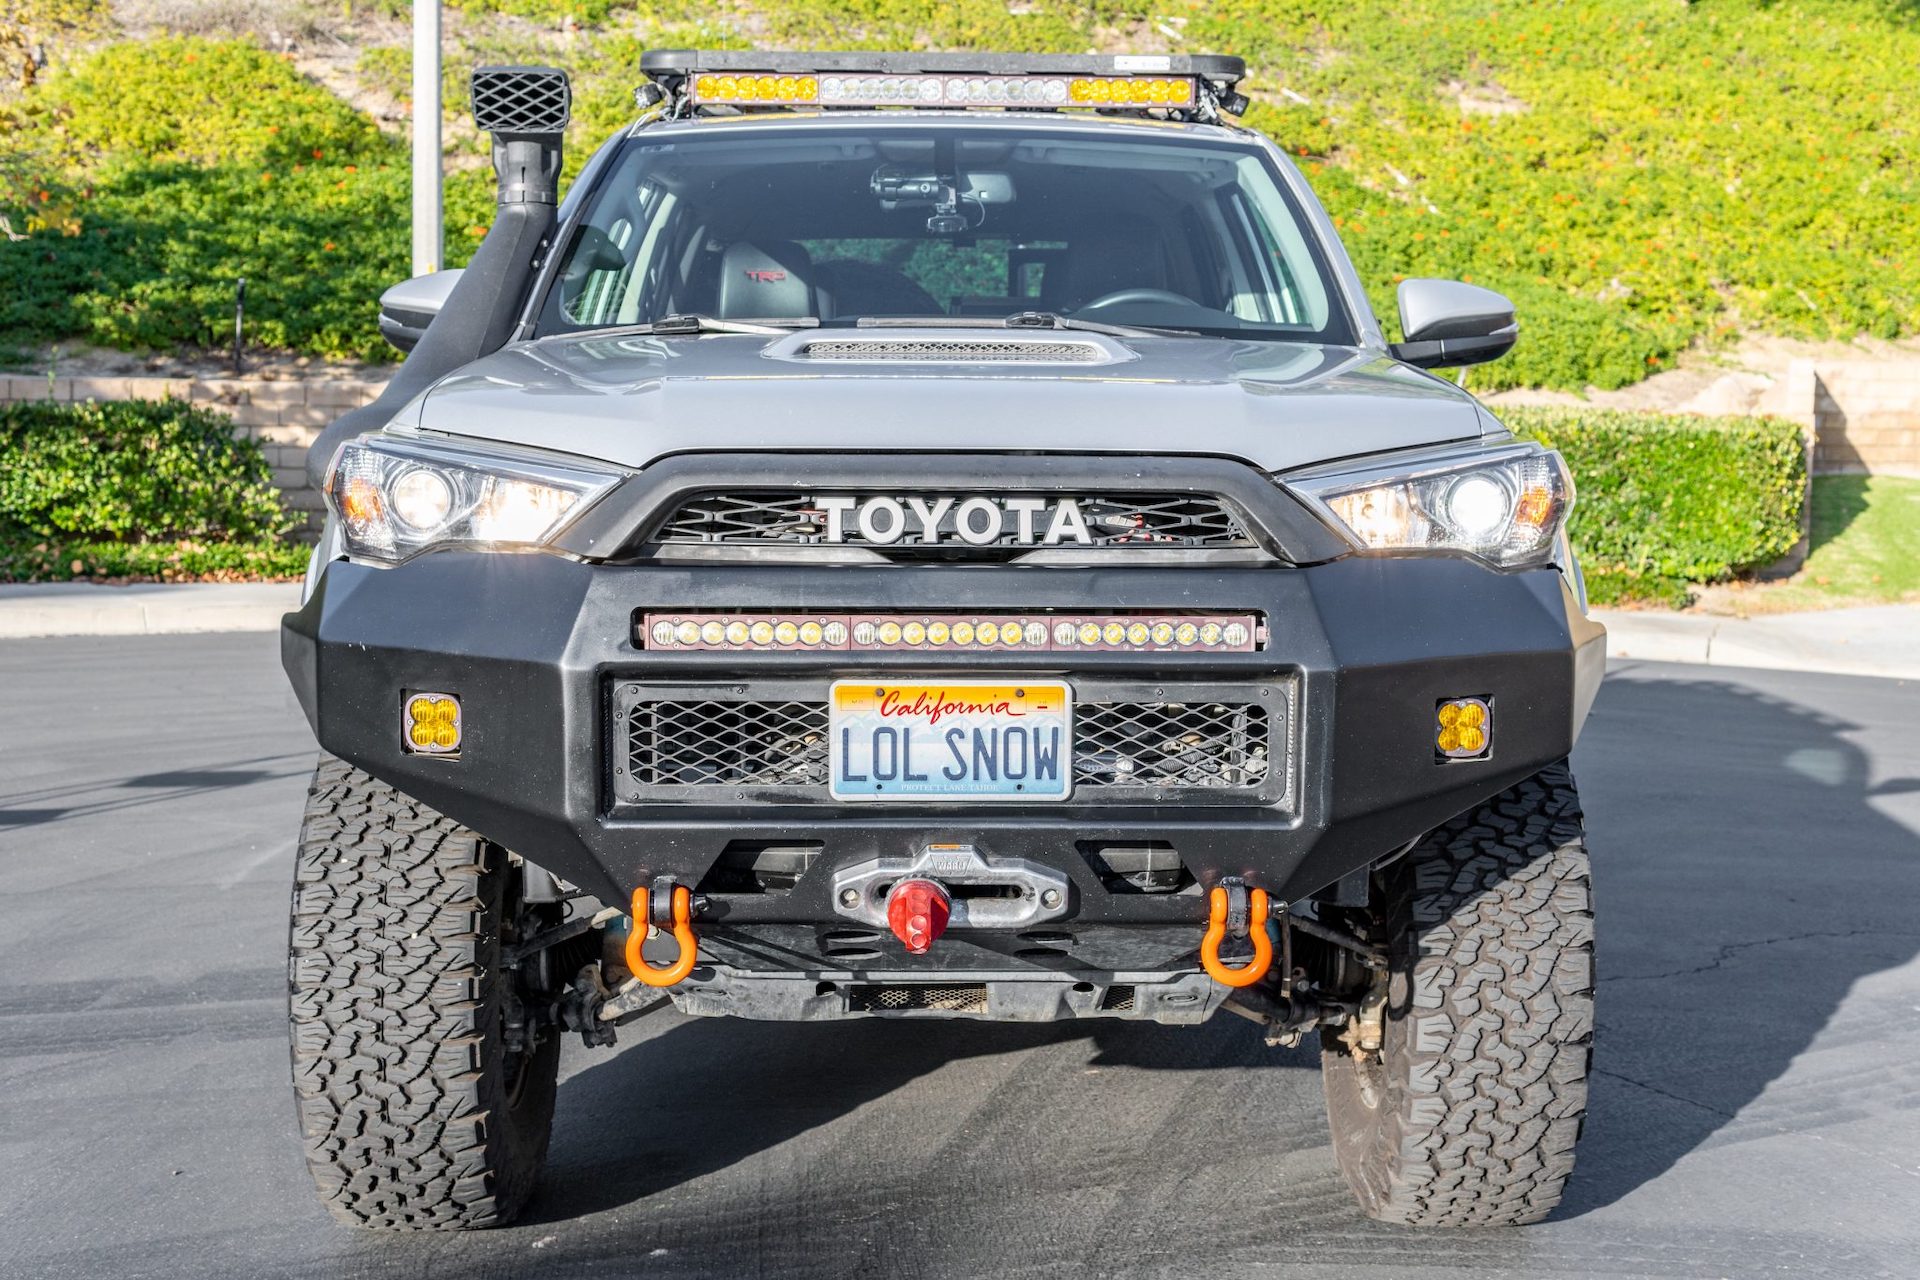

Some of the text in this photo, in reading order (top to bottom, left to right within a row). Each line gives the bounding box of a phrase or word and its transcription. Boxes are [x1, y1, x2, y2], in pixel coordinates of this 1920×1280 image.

[744, 270, 785, 283] TRD
[815, 496, 1093, 545] TOYOTA
[880, 691, 1026, 725] California
[842, 726, 1059, 782] LOL SNOW
